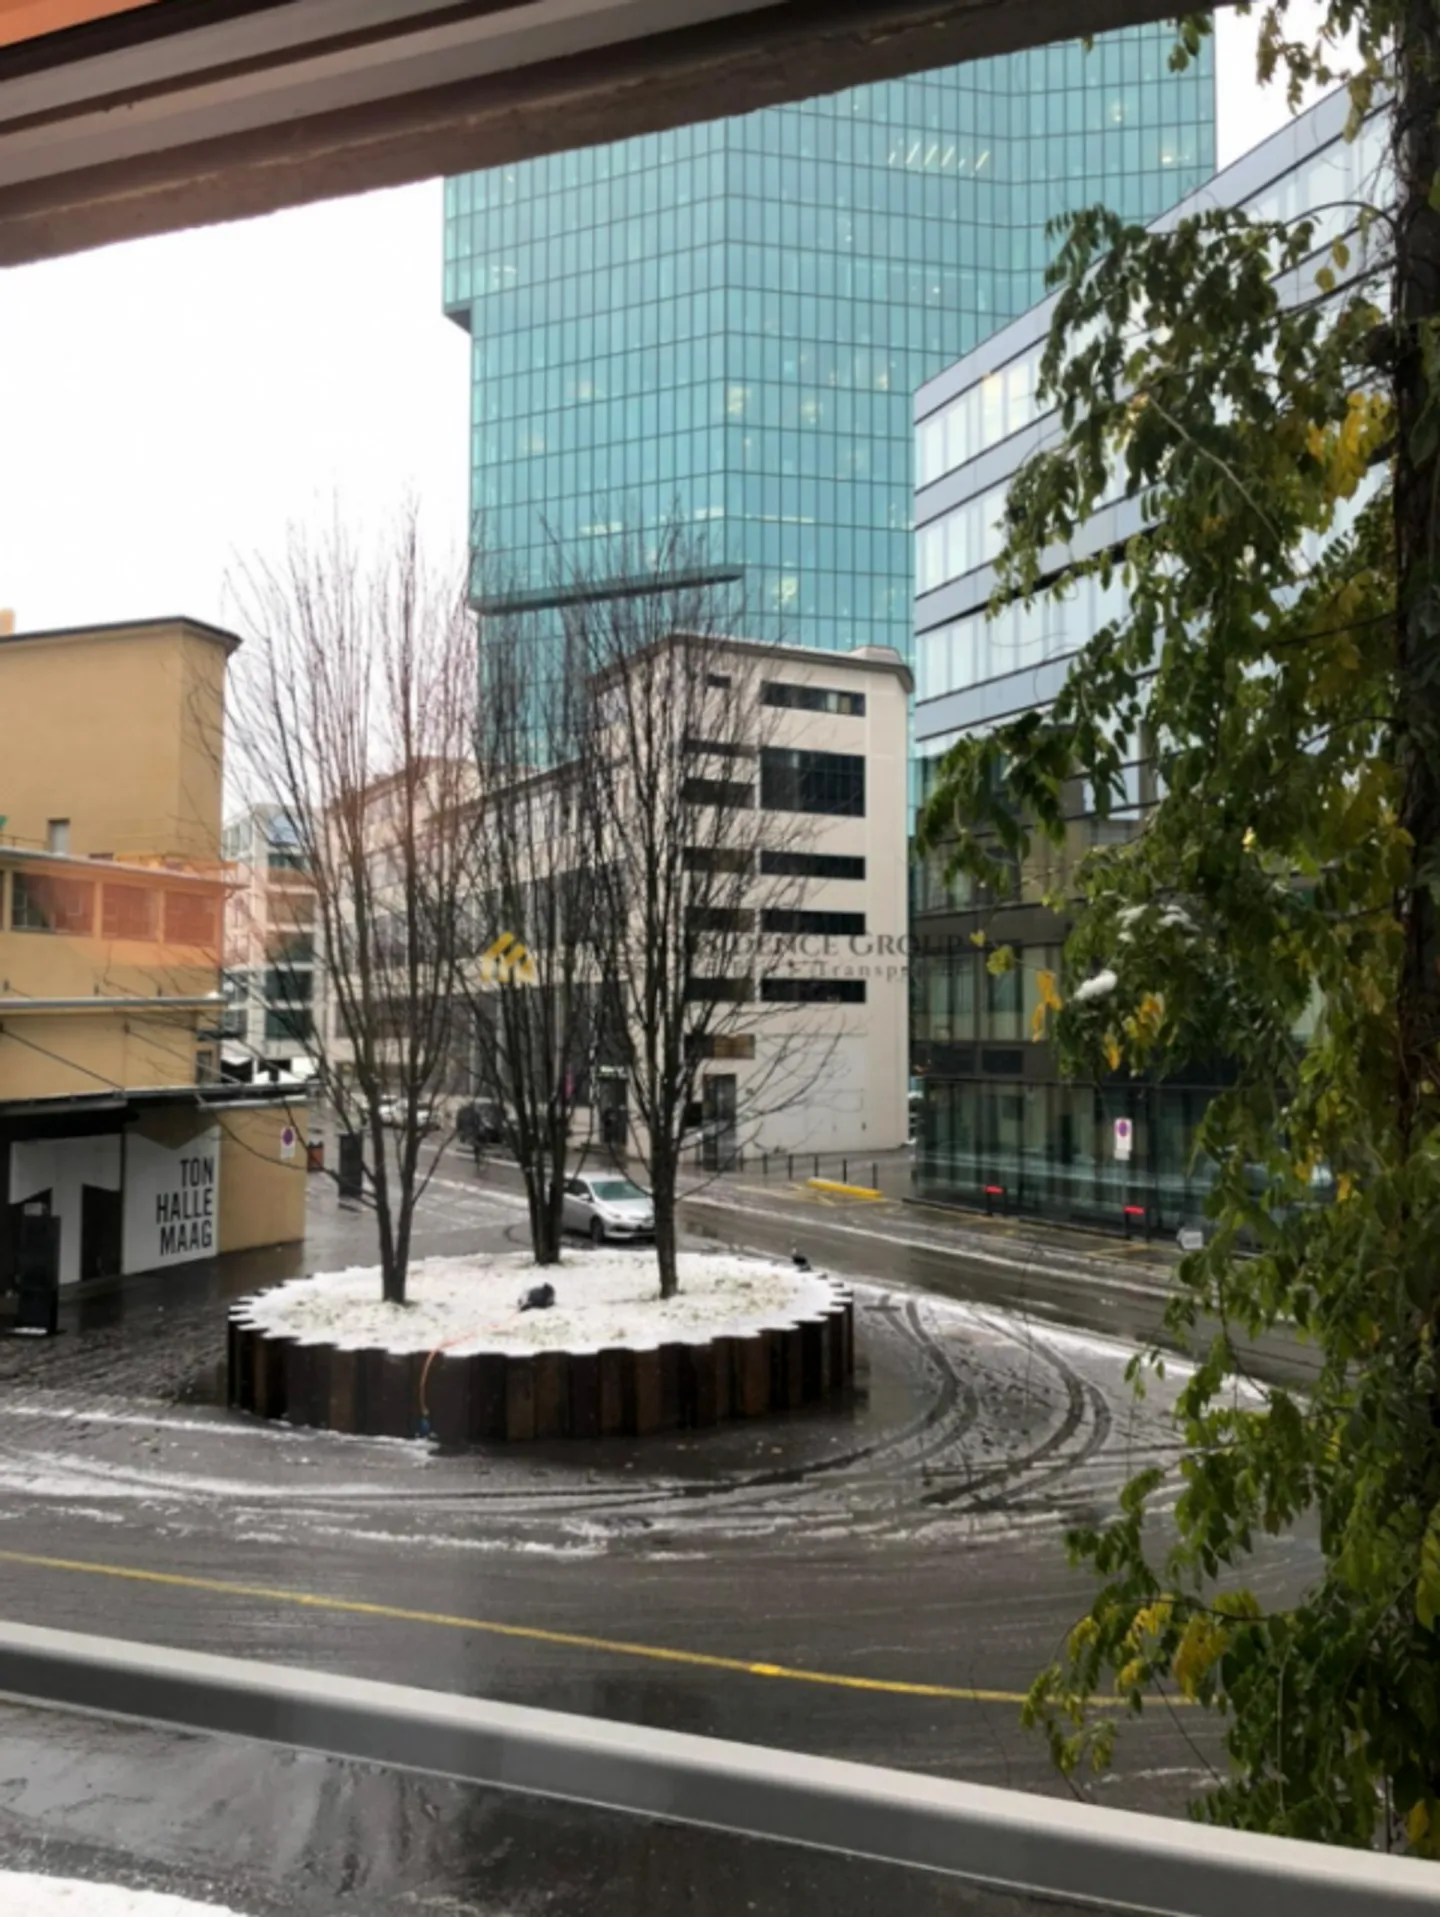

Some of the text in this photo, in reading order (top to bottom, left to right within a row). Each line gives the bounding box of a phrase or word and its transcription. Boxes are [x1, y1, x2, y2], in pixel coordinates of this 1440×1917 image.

[180, 1157, 214, 1188] TON
[156, 1188, 213, 1225] HALLE
[159, 1219, 213, 1257] MAAG
